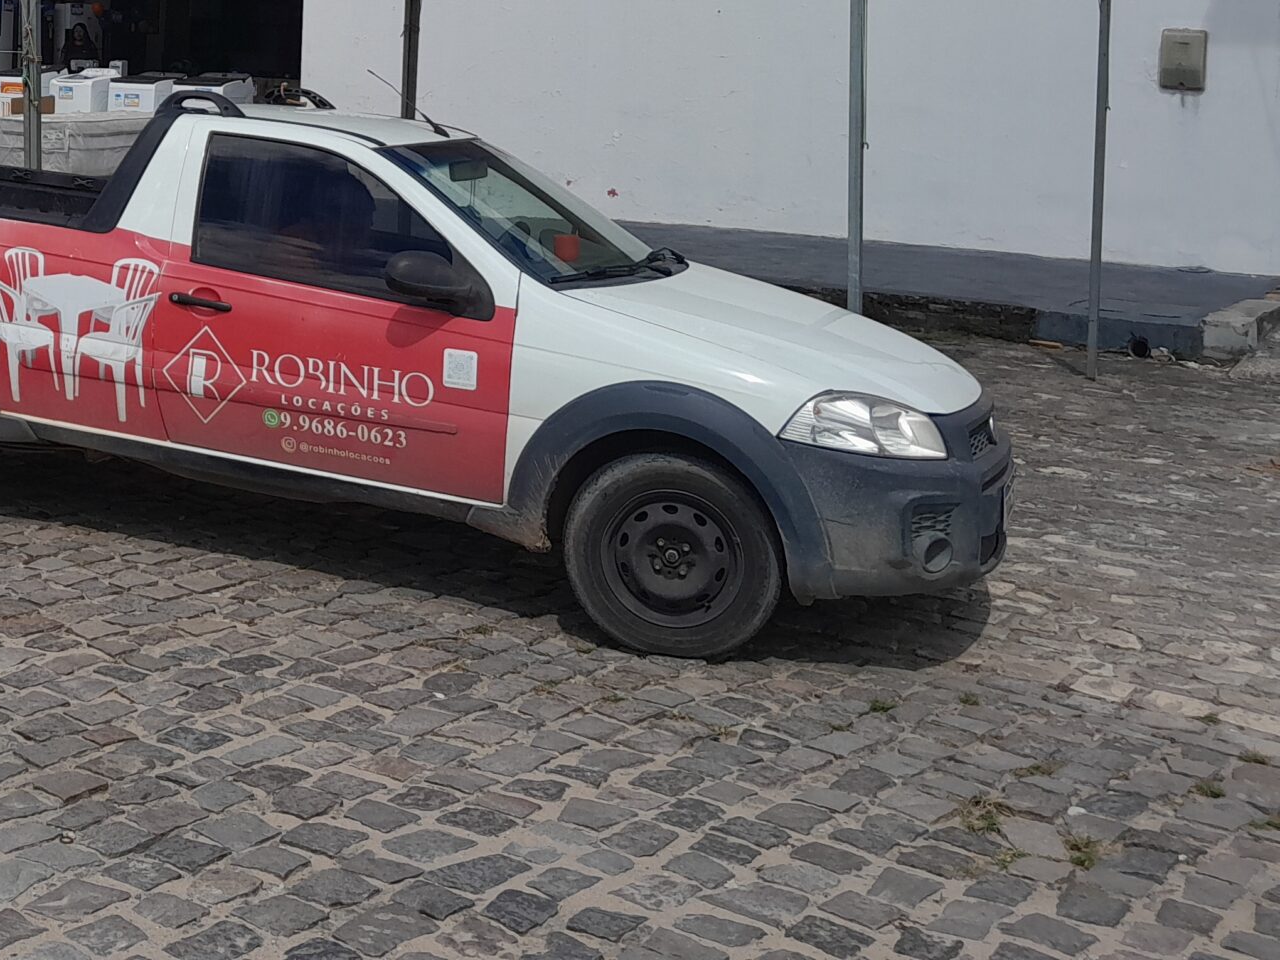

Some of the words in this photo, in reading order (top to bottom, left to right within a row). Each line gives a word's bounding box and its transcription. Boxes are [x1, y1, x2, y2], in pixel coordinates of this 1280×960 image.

[250, 349, 435, 407] ROBINHO
[281, 394, 389, 420] LOCAÇÕES
[280, 411, 407, 448] 9.9686-0623
